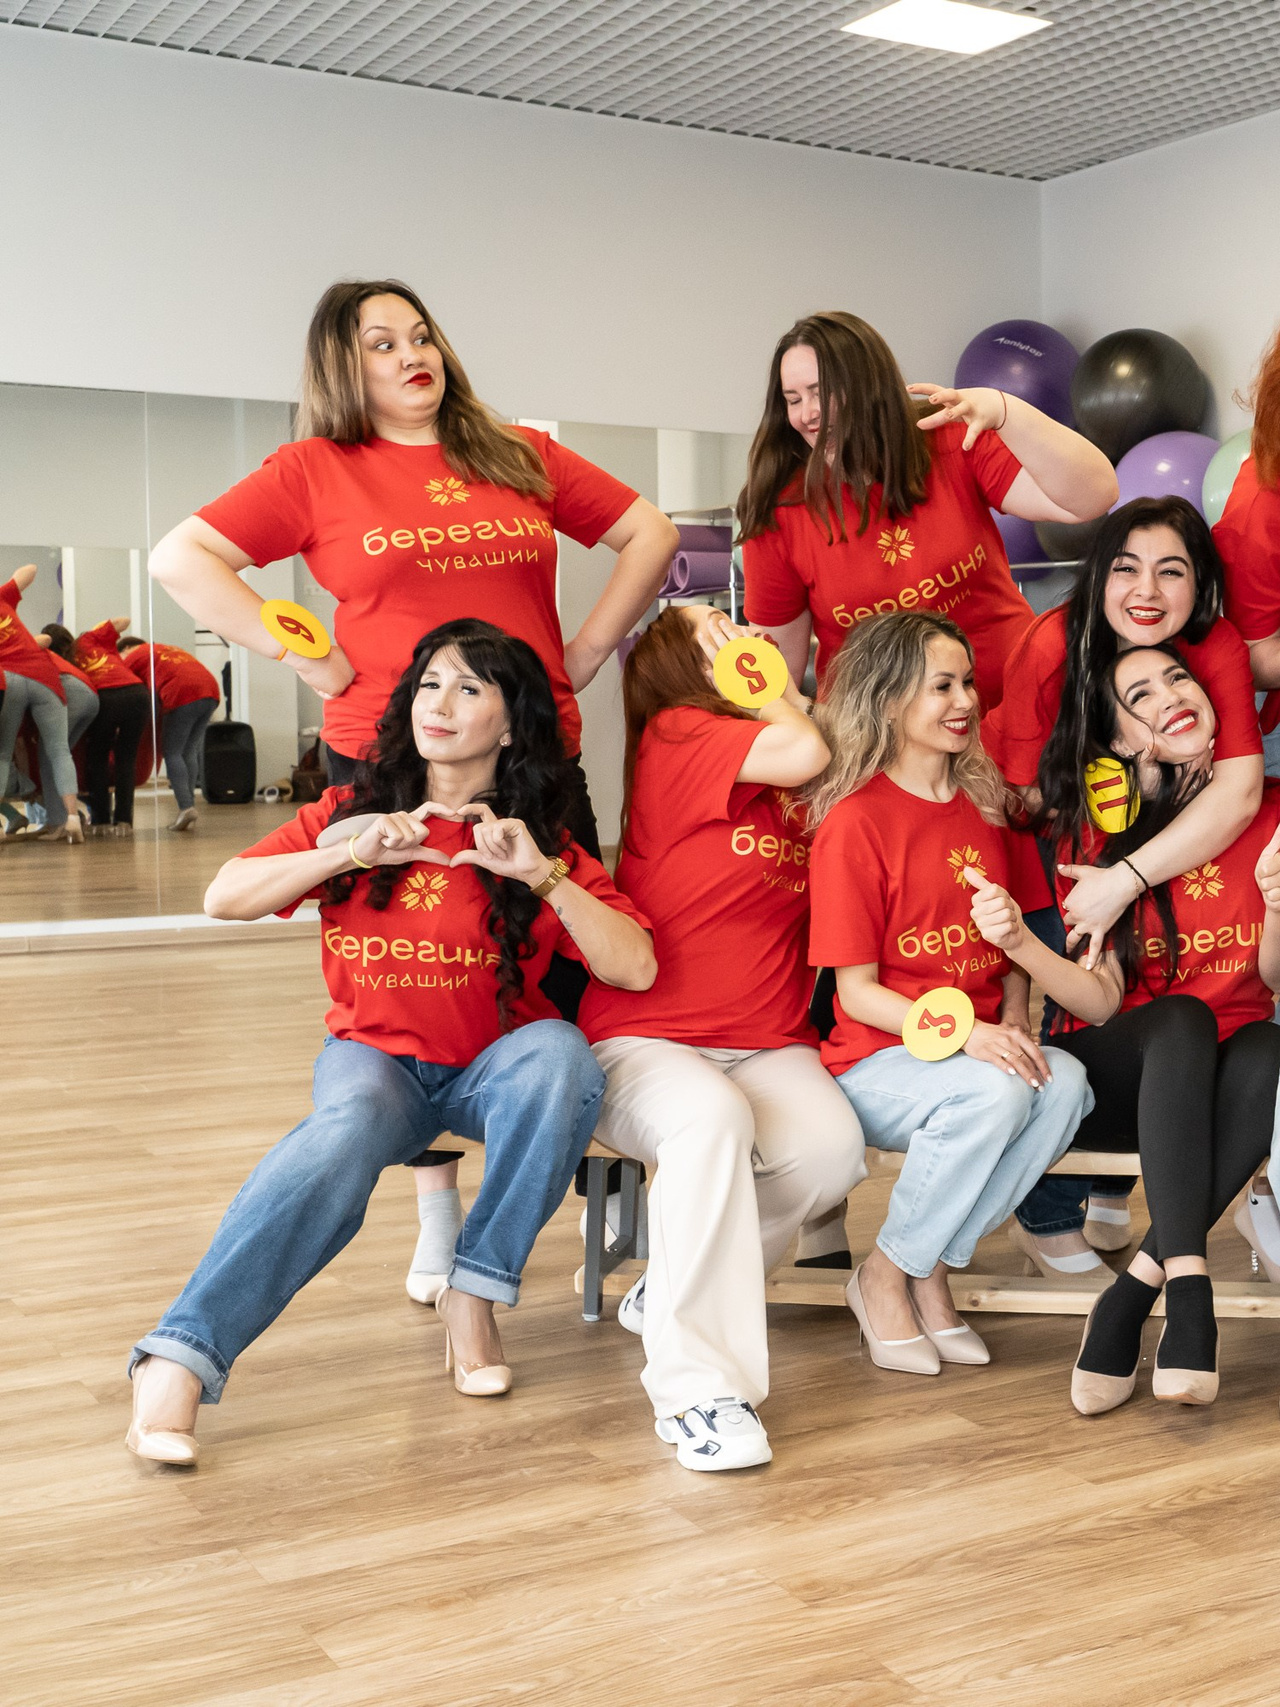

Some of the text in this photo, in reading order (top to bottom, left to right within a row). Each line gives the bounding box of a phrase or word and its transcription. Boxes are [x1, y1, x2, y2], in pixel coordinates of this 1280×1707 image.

[362, 517, 554, 556] берегиня
[416, 549, 538, 573] чувашии
[735, 652, 768, 695] 5
[1090, 774, 1128, 815] 11
[731, 824, 810, 868] бере
[897, 919, 981, 958] бере
[353, 973, 469, 991] чувашии
[942, 949, 1002, 977] чуваш
[917, 1008, 956, 1038] 3
